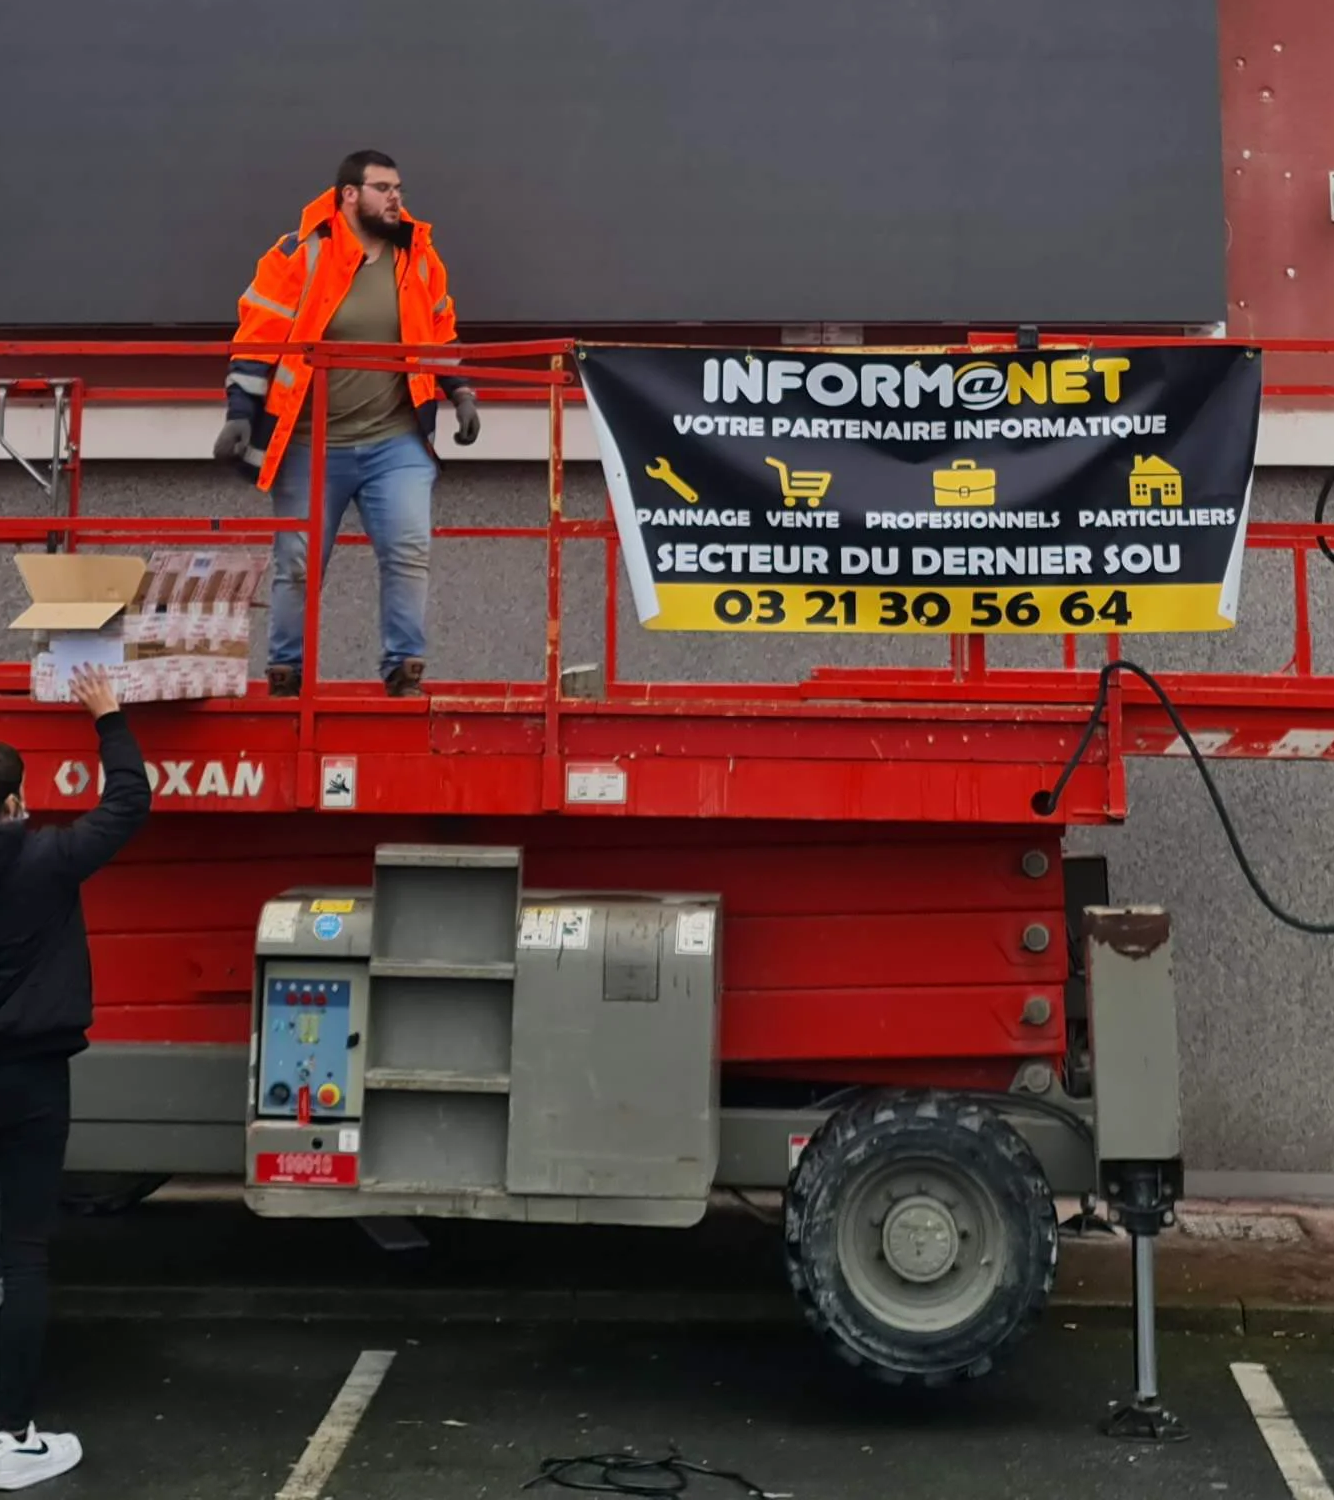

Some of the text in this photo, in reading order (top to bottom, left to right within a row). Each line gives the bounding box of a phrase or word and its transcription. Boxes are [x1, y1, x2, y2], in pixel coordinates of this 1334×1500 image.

[703, 357, 1130, 411] INFORM@NET
[673, 415, 1167, 441] VOTRE PARTENAIRE INFORMATIQUE
[766, 510, 840, 528] VENTE
[866, 511, 1060, 529] PROFESSIONNELS
[1079, 508, 1236, 527] PARTICULIERS
[657, 542, 1181, 575] SECTEUR DU DERNIER SOU
[714, 589, 1132, 627] 03 21 30 56 64
